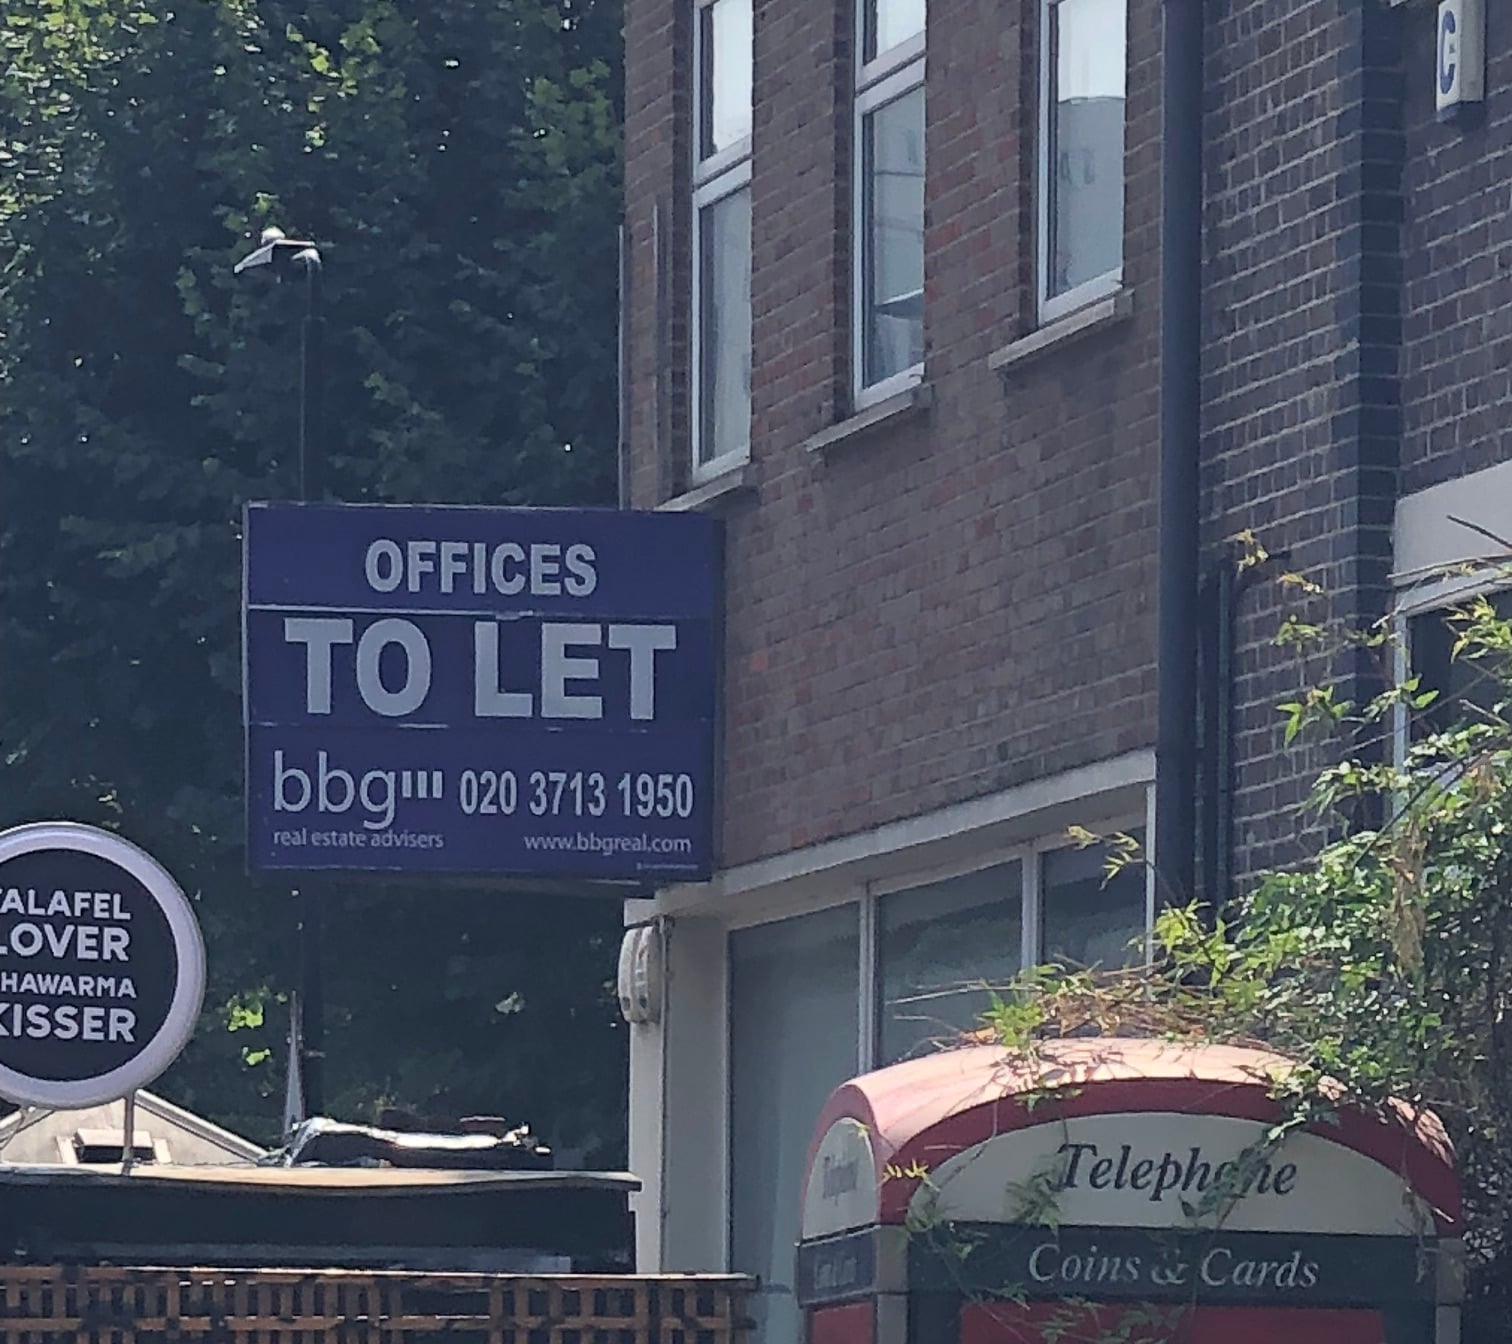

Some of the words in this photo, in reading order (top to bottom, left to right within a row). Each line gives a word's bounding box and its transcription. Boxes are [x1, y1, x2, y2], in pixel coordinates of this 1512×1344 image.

[365, 539, 597, 596] OFFICES
[285, 618, 432, 717] TO
[474, 621, 677, 720] LET
[459, 769, 518, 815] 020
[529, 771, 606, 816] 3713
[618, 773, 694, 817] 1950
[273, 827, 307, 846] real
[311, 830, 366, 847] estate
[370, 829, 444, 848] advisers
[523, 832, 692, 856] www.bbgreal.com
[0, 888, 131, 920] ALAFEL
[1029, 1243, 1142, 1282] Coins
[1201, 1247, 1320, 1288] Cards
